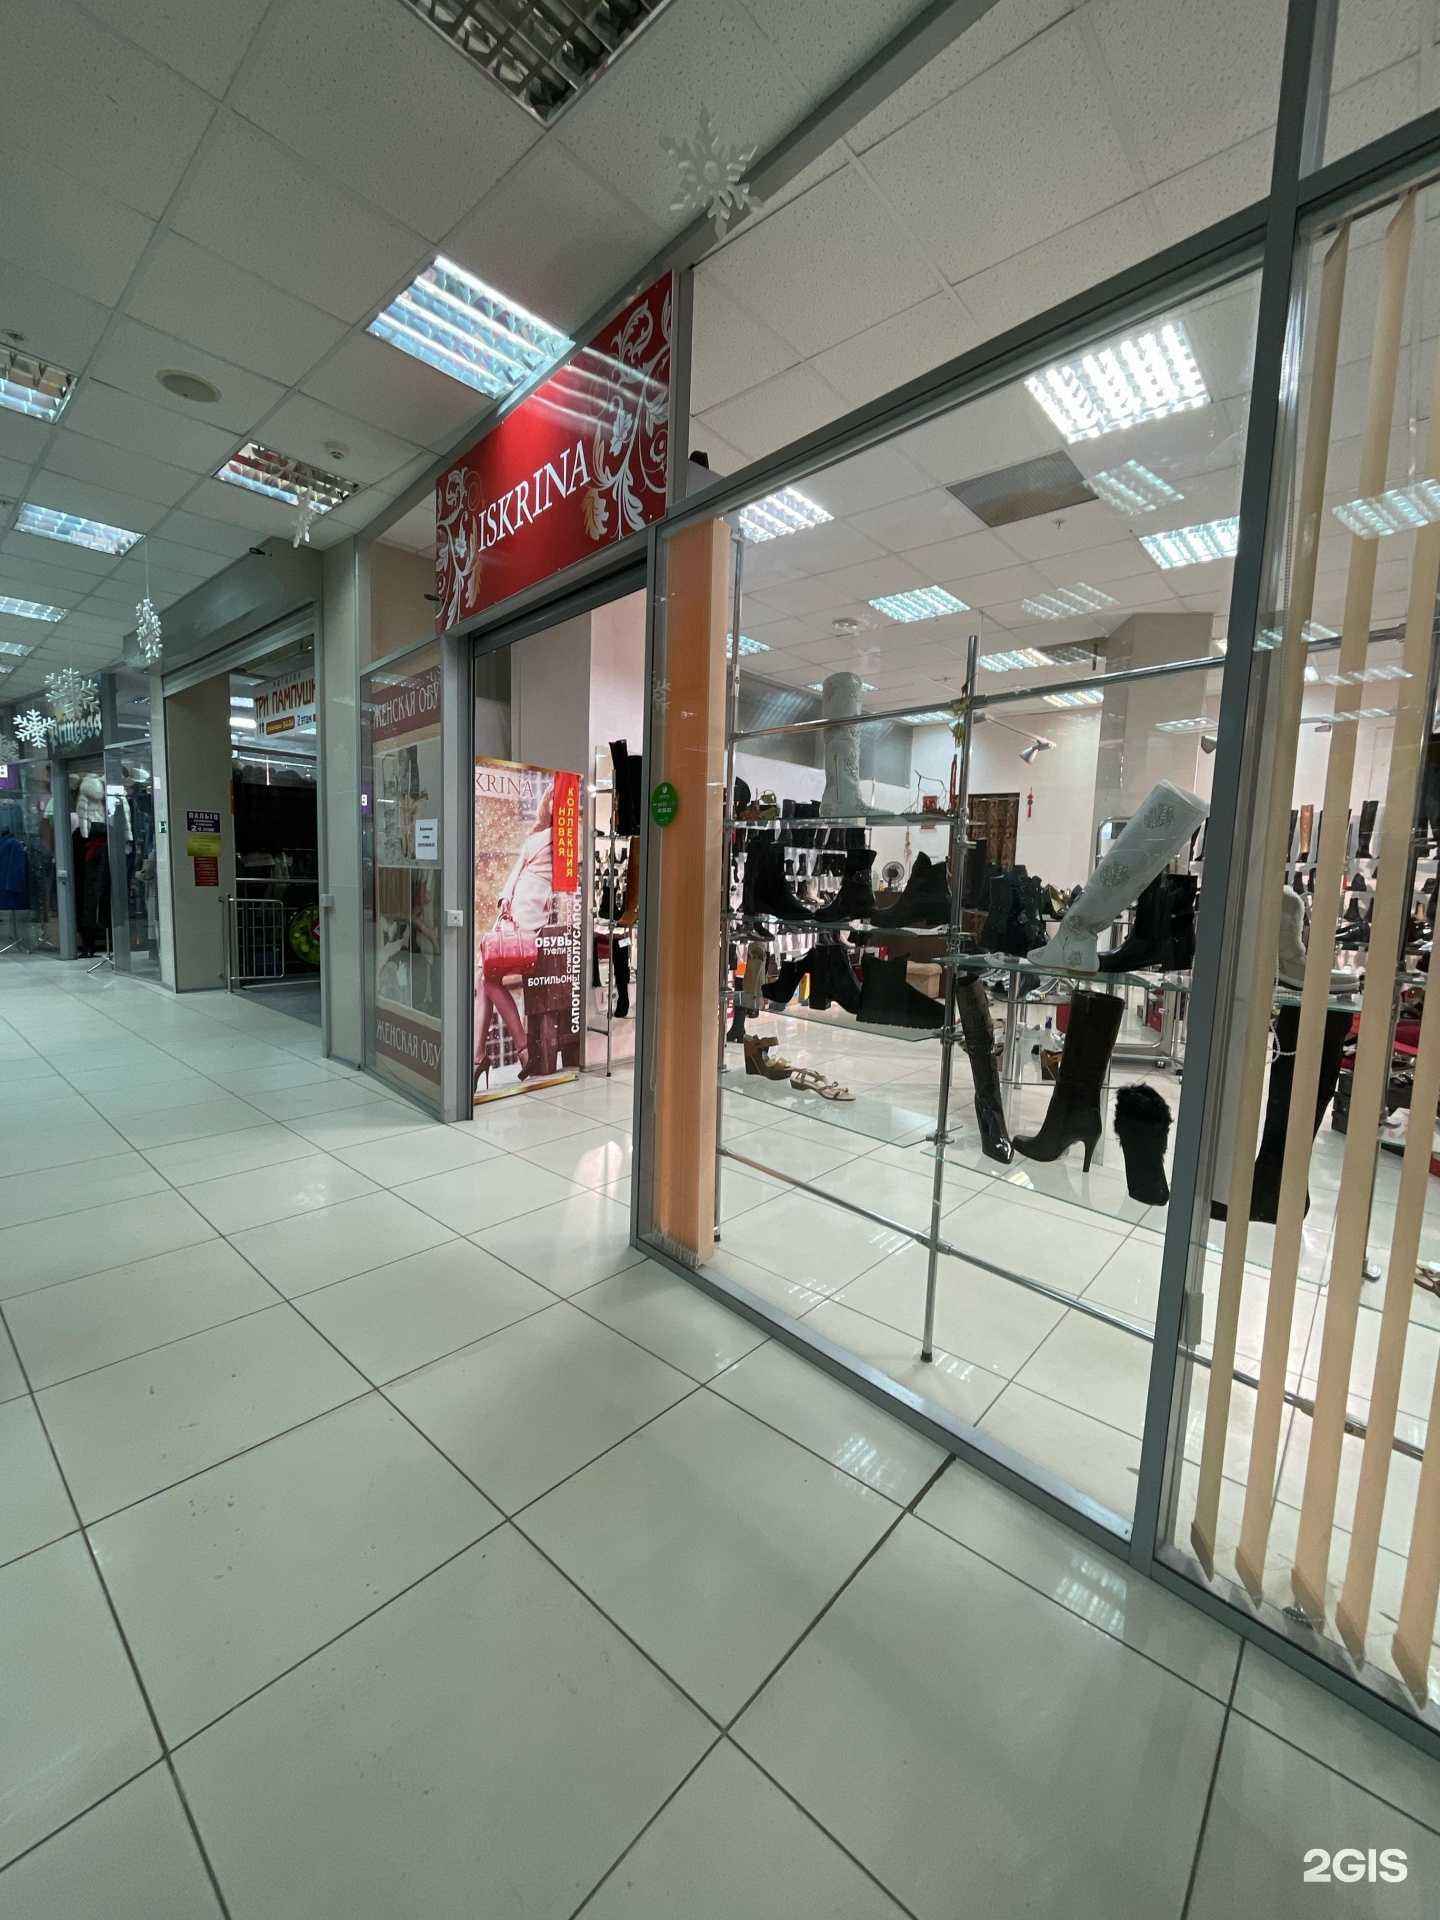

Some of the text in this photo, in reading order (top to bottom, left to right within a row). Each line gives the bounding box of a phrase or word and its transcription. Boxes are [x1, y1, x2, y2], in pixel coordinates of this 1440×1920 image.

[478, 440, 591, 552] ISKRINA
[373, 690, 416, 729] ЖЕНСКАЯ
[566, 787, 575, 878] КОЛЛЕКЦИЯ
[535, 935, 572, 948] ОБУВЬ
[543, 947, 566, 956] ТУФЛИ
[571, 981, 581, 1033] САПОГИ
[376, 1018, 418, 1059] ЖЕНСКАЯ
